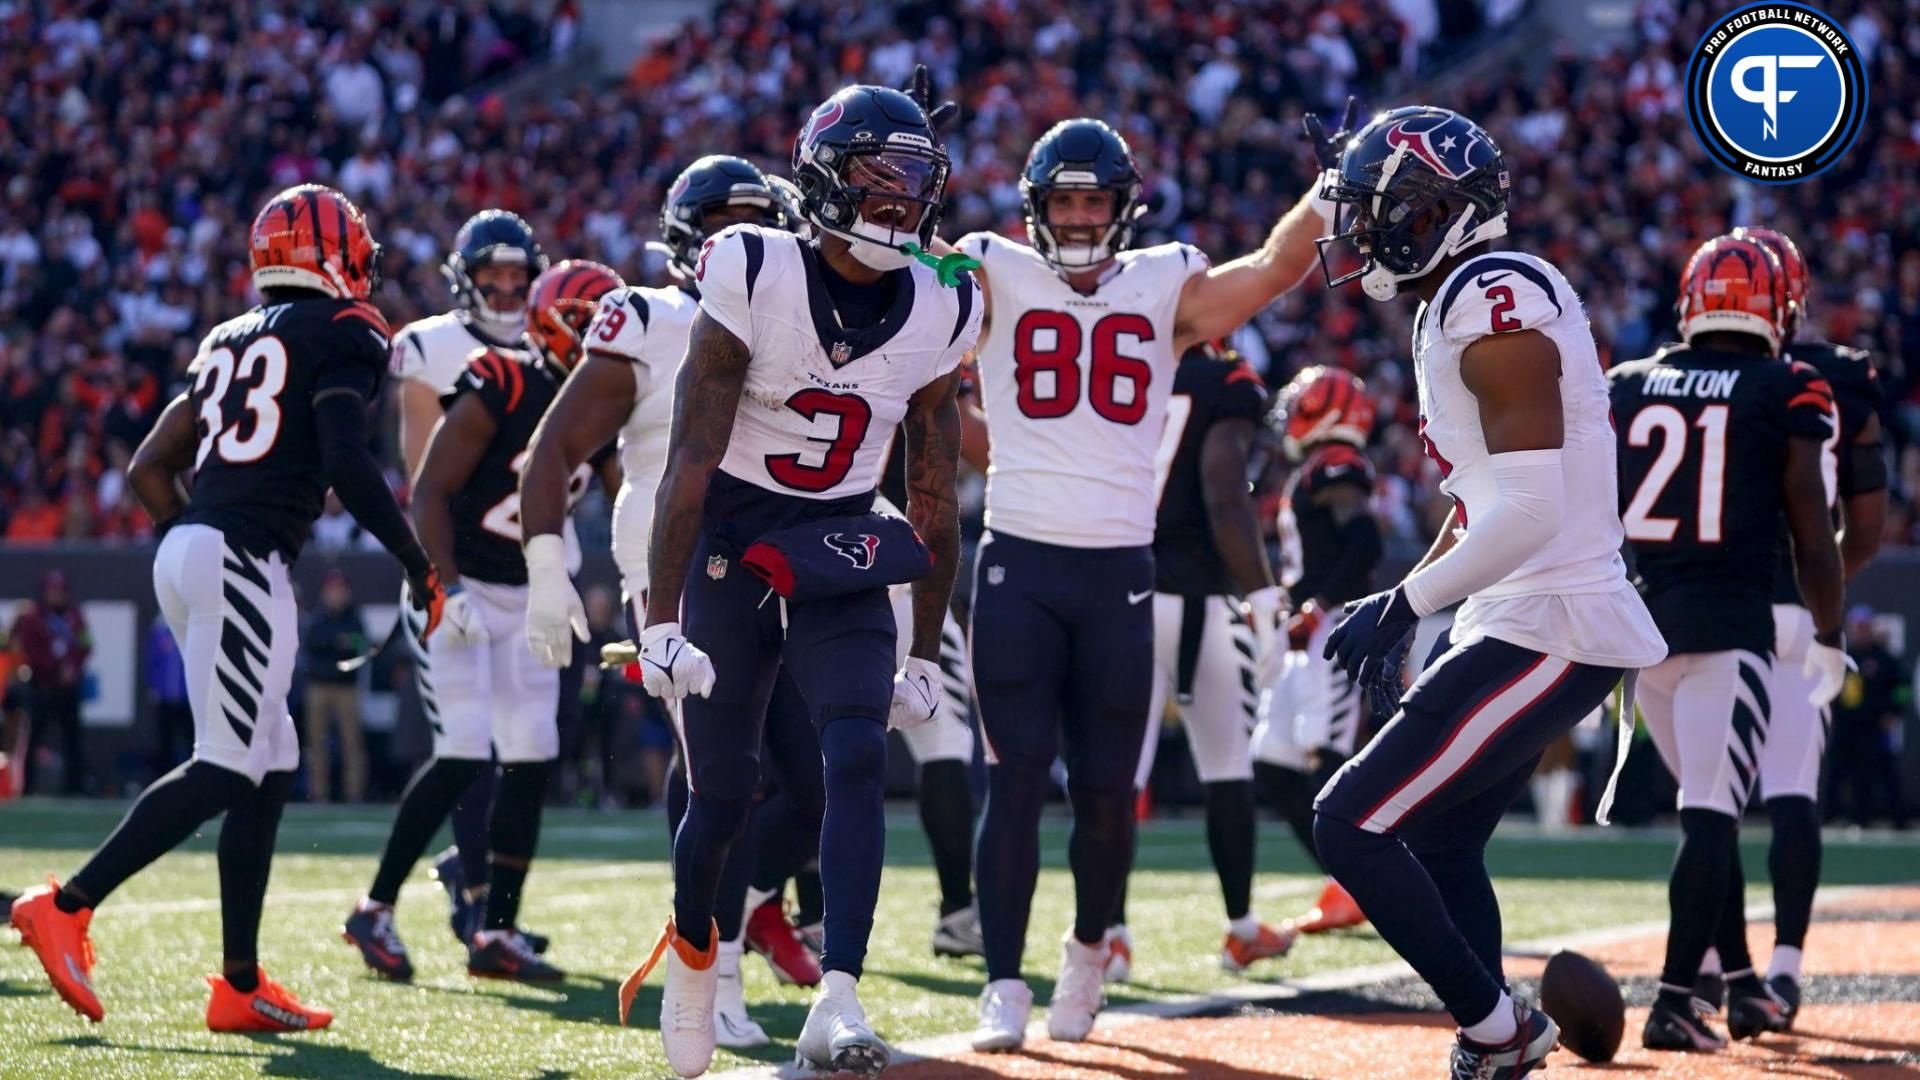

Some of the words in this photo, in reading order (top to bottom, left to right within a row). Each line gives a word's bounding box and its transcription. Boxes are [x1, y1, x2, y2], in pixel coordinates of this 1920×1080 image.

[896, 134, 927, 143] TEXANS
[1485, 285, 1522, 332] 2
[193, 333, 289, 472] 33
[807, 371, 860, 390] TEXANS
[1013, 309, 1156, 426] 86
[1641, 368, 1740, 399] HILTON
[764, 387, 872, 493] 3
[1622, 403, 1730, 543] 21
